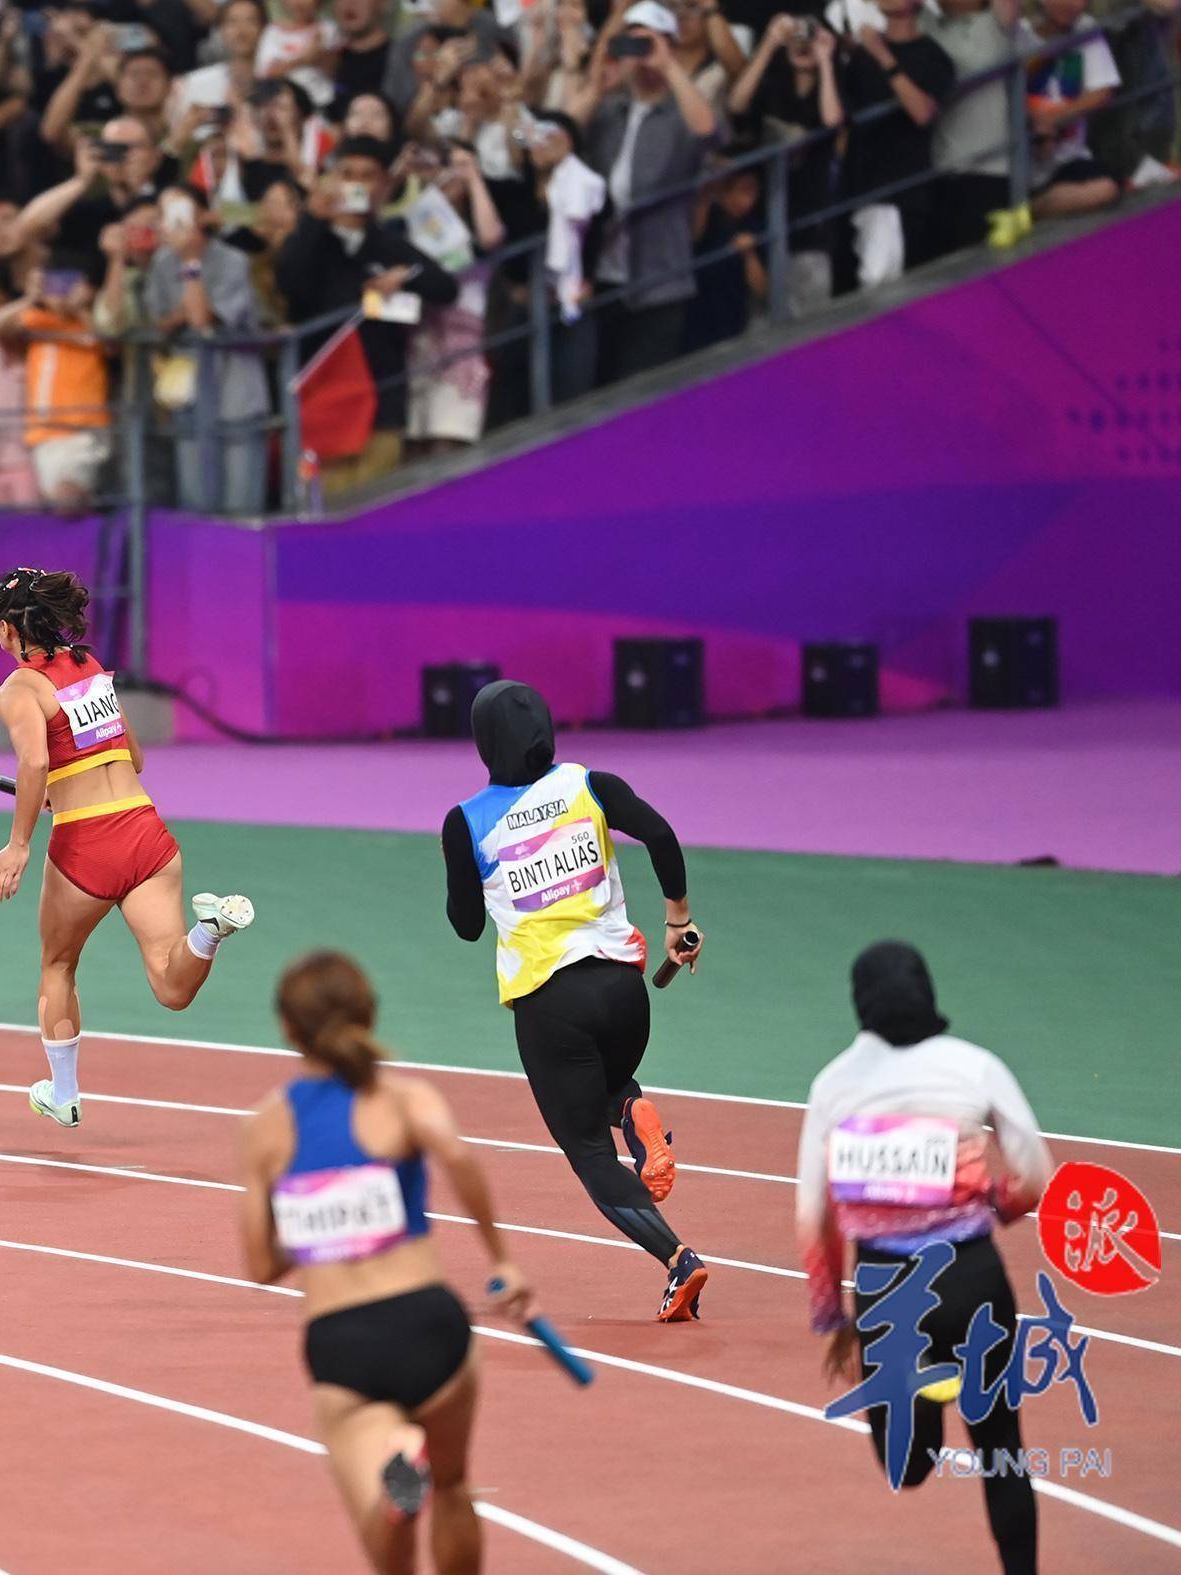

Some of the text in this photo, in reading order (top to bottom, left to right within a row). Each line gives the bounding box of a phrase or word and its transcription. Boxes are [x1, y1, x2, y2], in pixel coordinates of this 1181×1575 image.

[506, 798, 569, 831] MALAYSIA
[571, 831, 590, 845] 560
[508, 841, 599, 894] BINTI ALIAS
[836, 1143, 948, 1179] HUSSAIN
